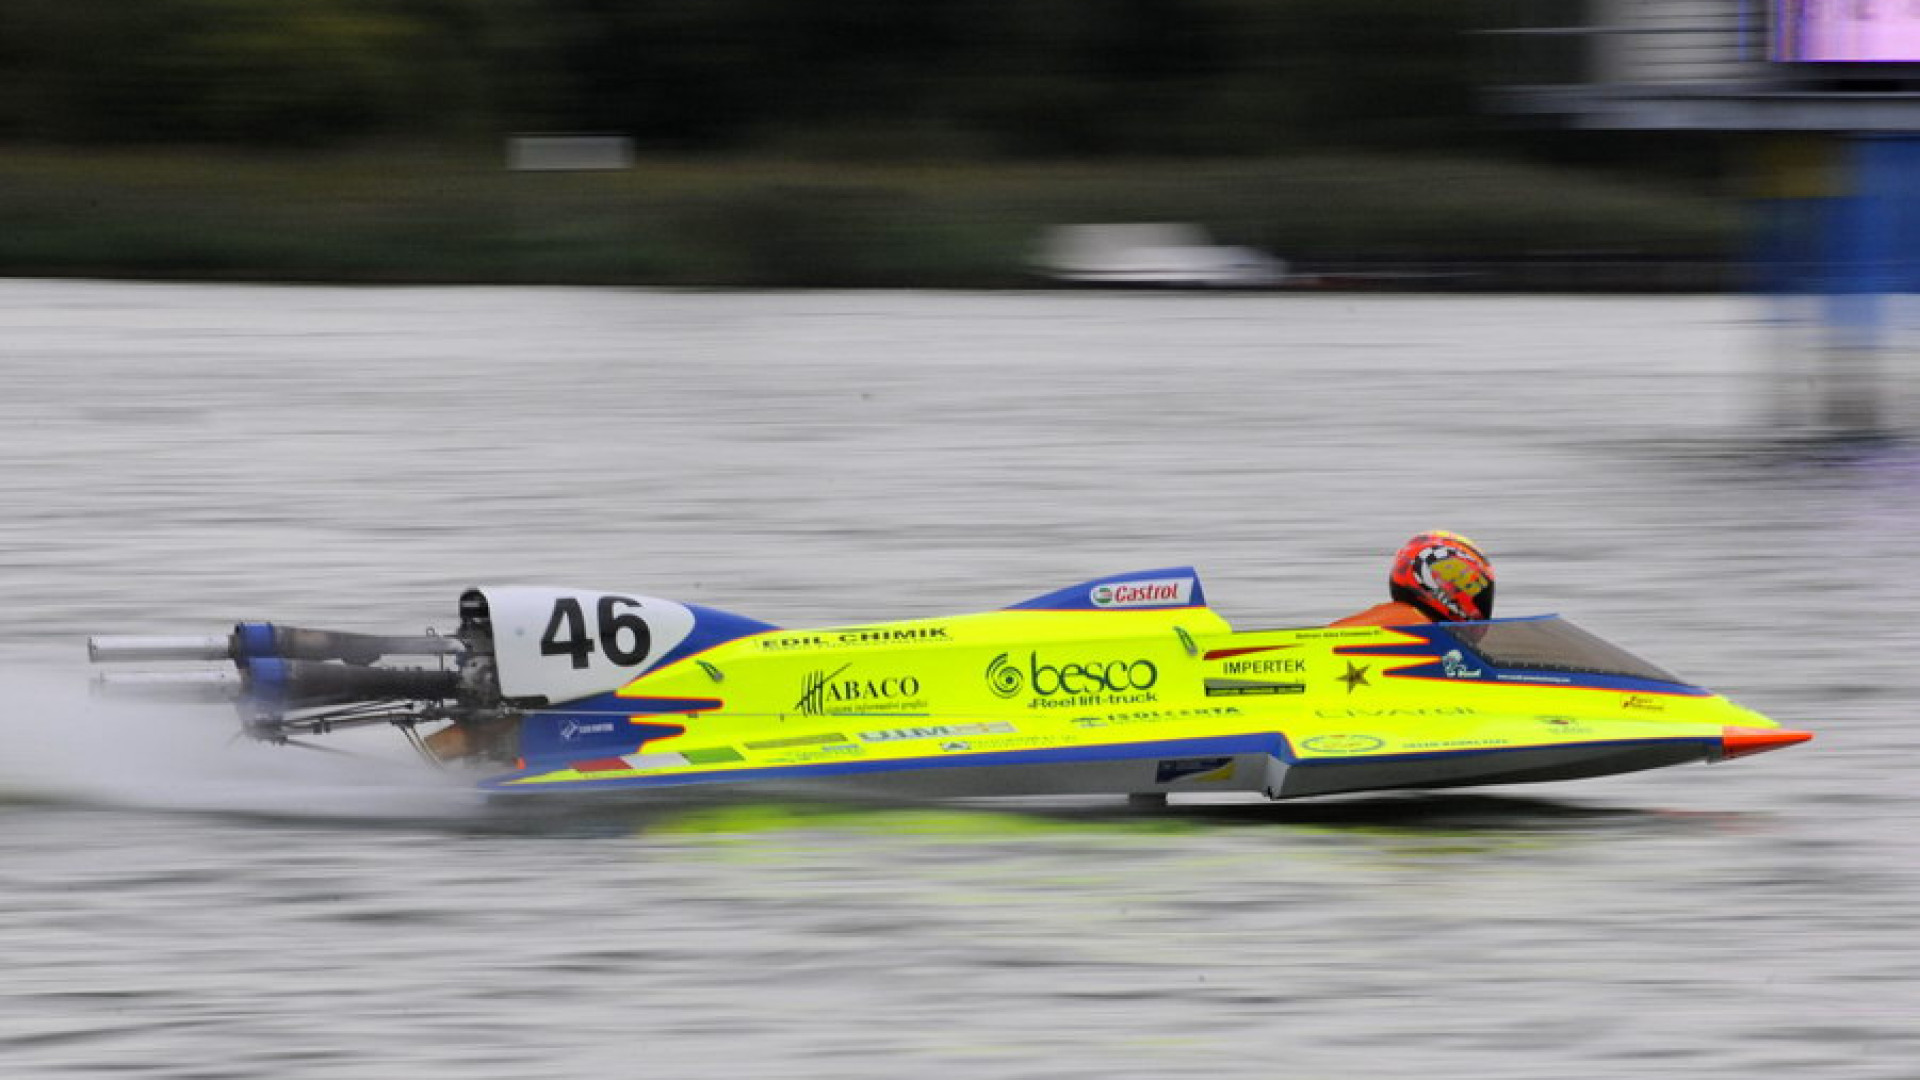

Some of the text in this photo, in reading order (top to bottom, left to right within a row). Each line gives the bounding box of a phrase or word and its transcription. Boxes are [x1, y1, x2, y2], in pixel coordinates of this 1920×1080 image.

[1115, 583, 1178, 603] Castrol
[540, 595, 651, 669] 46
[838, 627, 948, 643] CHIMIK
[1029, 650, 1158, 696] besco
[1223, 659, 1305, 674] IMPERTEK
[826, 676, 920, 701] ABACO
